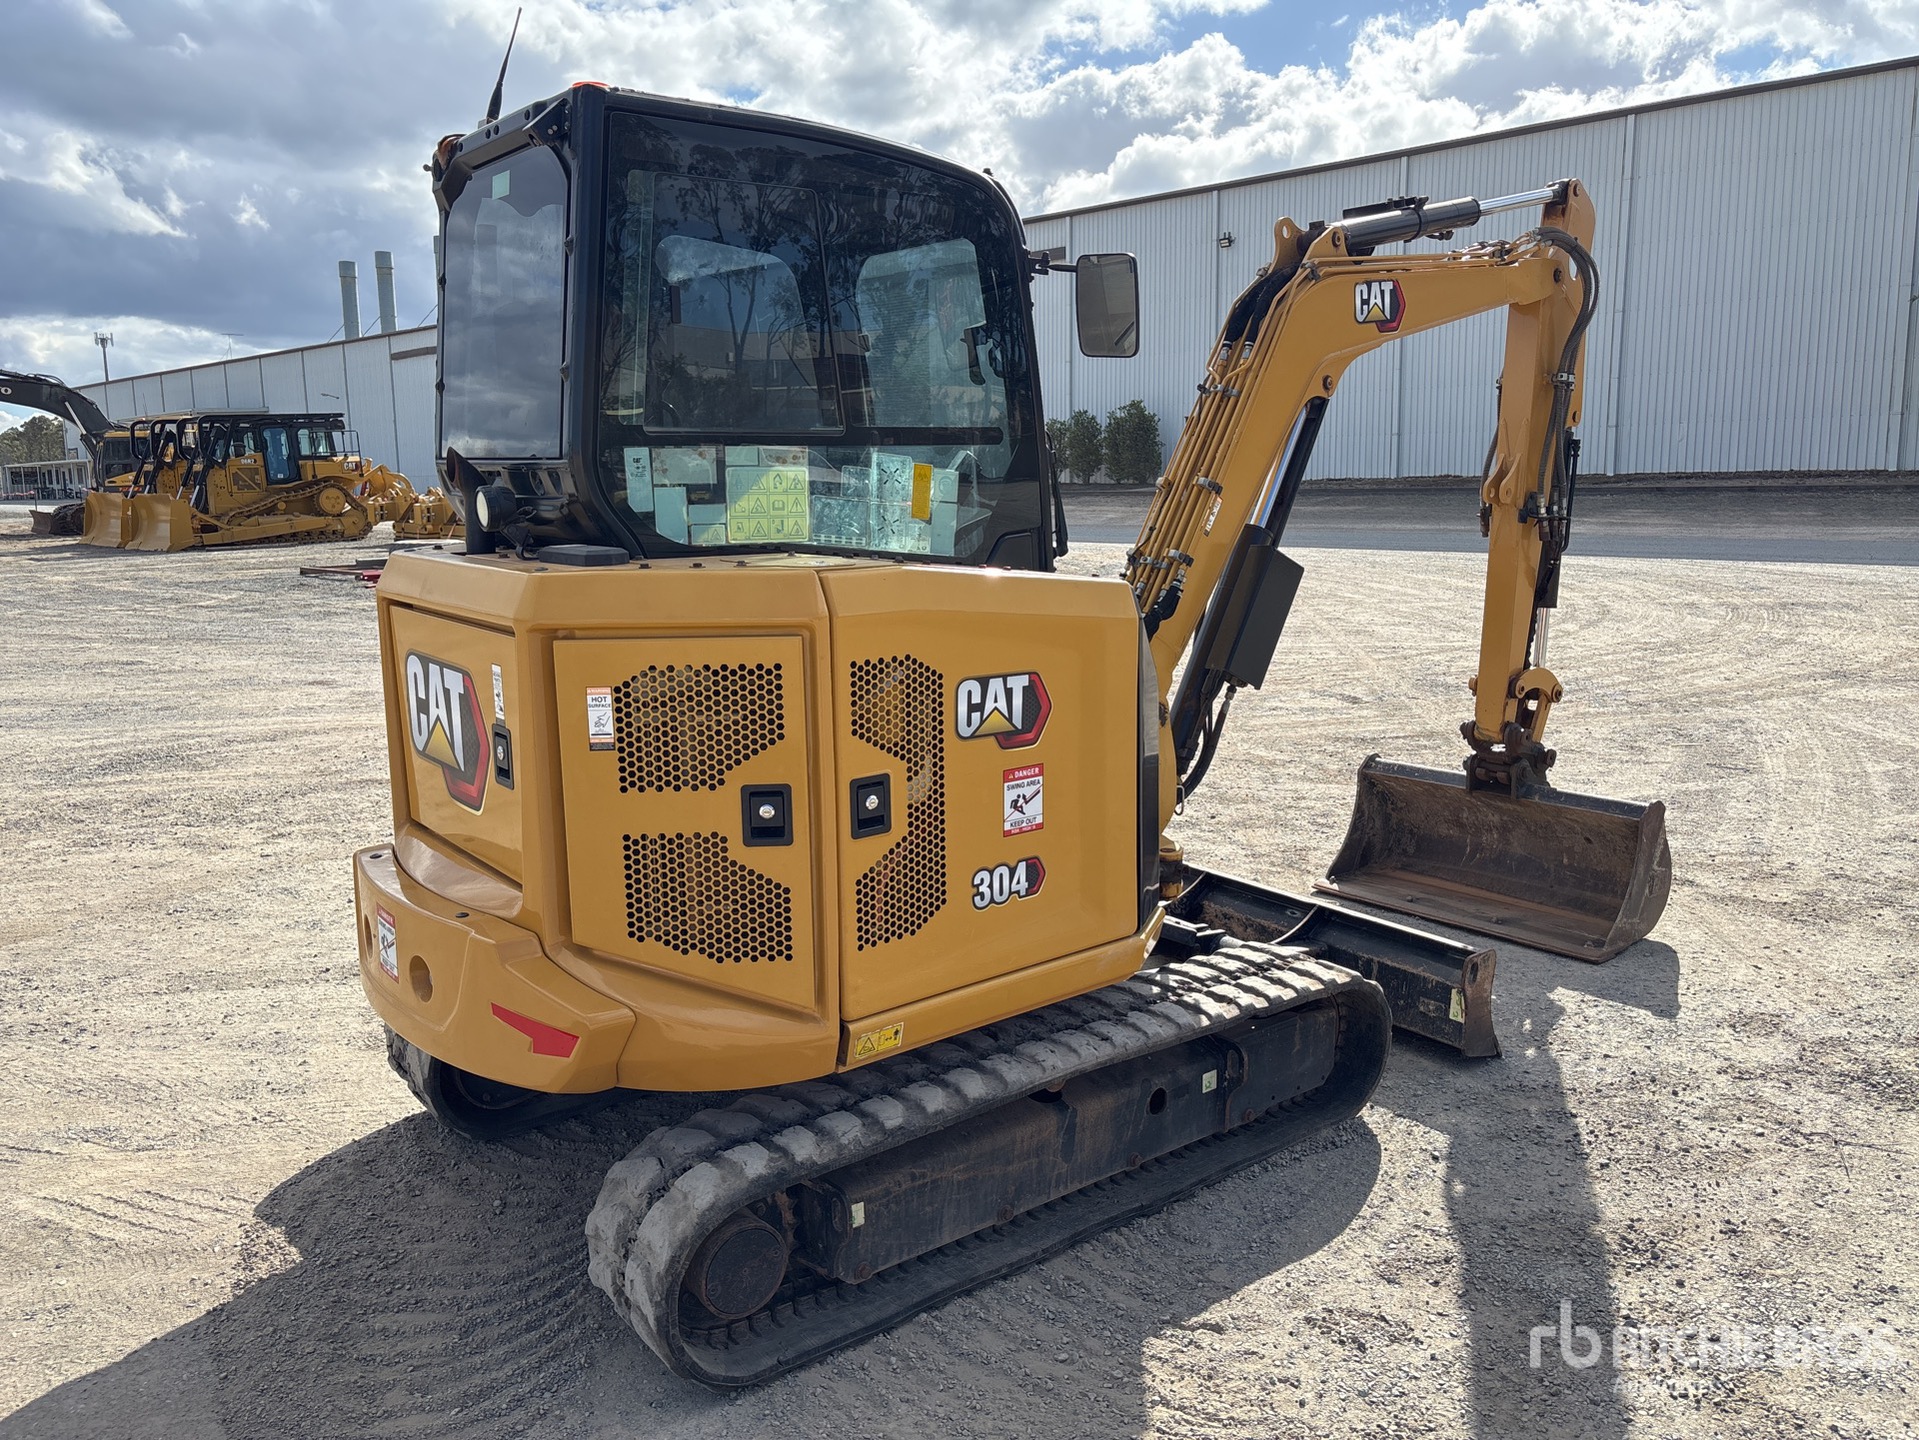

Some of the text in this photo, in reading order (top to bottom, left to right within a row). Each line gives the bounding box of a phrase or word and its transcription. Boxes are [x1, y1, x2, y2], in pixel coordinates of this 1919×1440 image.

[1354, 281, 1394, 323] CAT
[344, 462, 357, 470] CAT
[405, 654, 465, 772] CAT
[957, 674, 1029, 738] CAT
[1006, 779, 1041, 791] SWING AREA
[1014, 767, 1040, 778] DANGER
[1010, 817, 1037, 828] KEEP OUT
[972, 860, 1029, 908] 304
